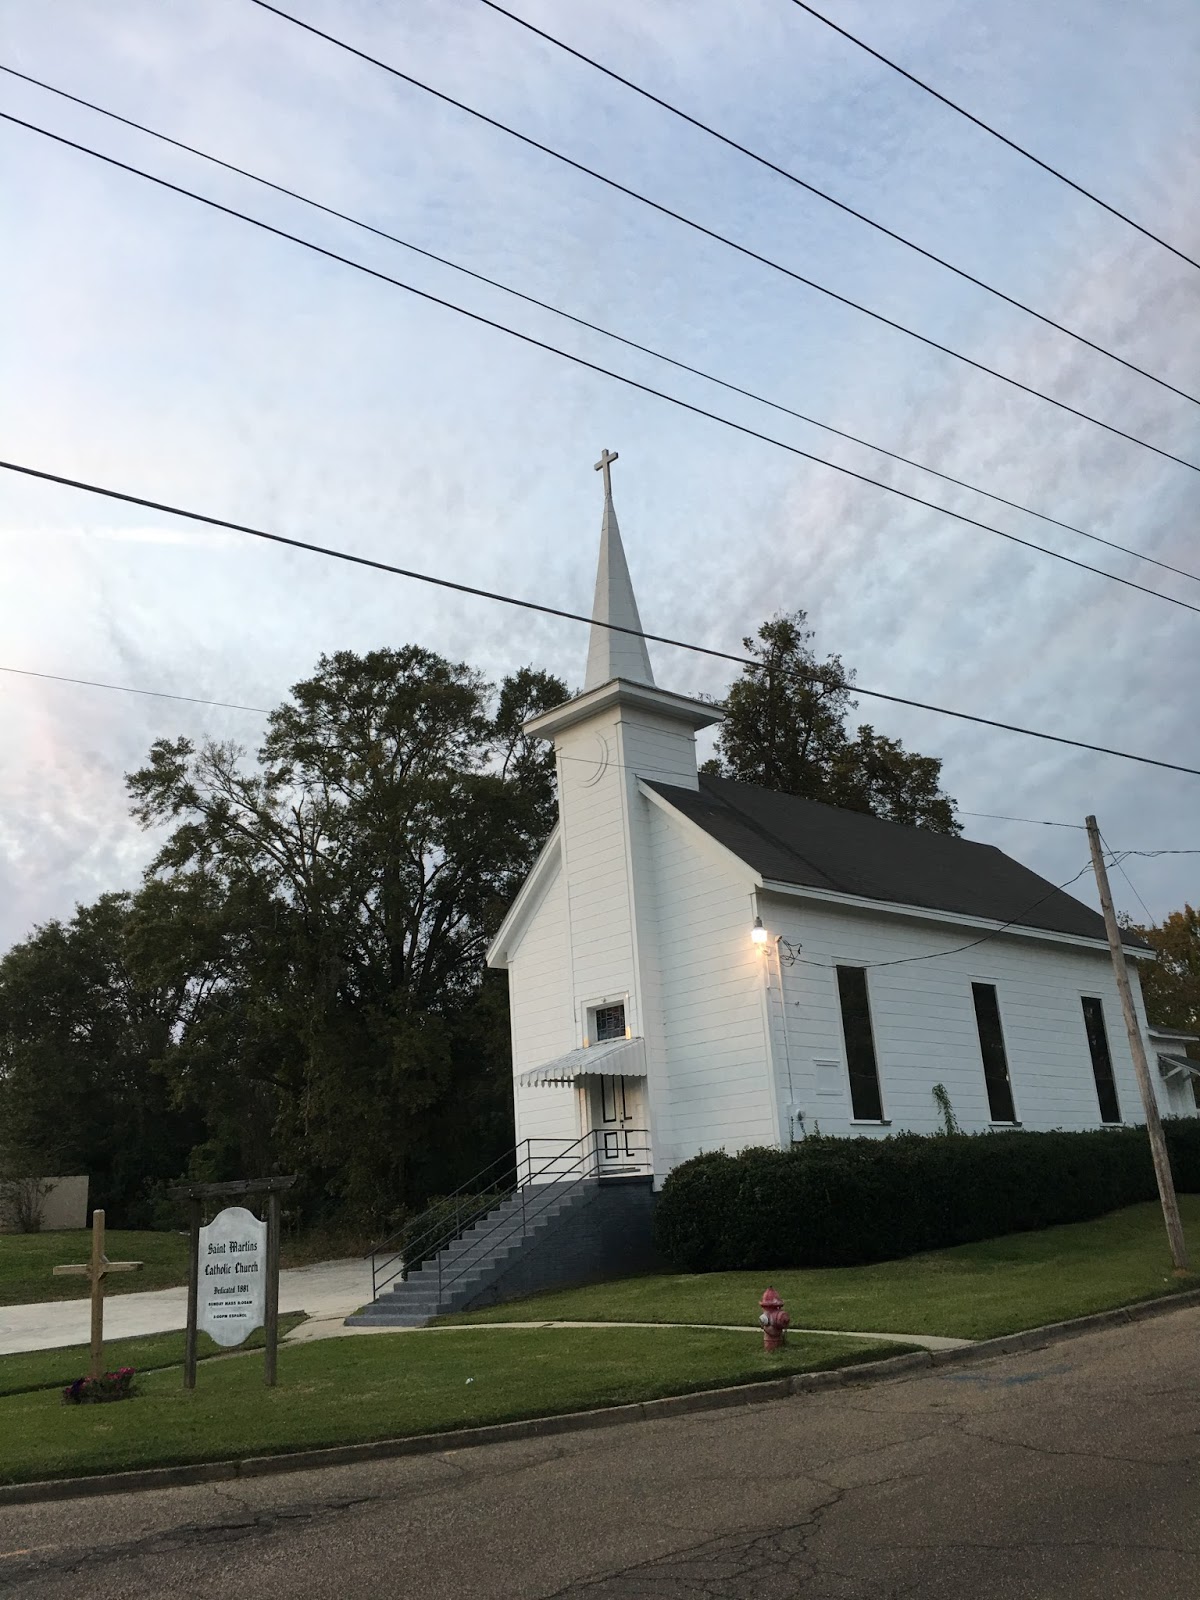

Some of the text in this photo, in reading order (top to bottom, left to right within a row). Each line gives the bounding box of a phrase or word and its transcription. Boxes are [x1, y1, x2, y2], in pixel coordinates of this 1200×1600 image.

[207, 1240, 258, 1255] Saint Martins
[205, 1261, 259, 1276] Catholic Church
[213, 1286, 236, 1295] Dedicated
